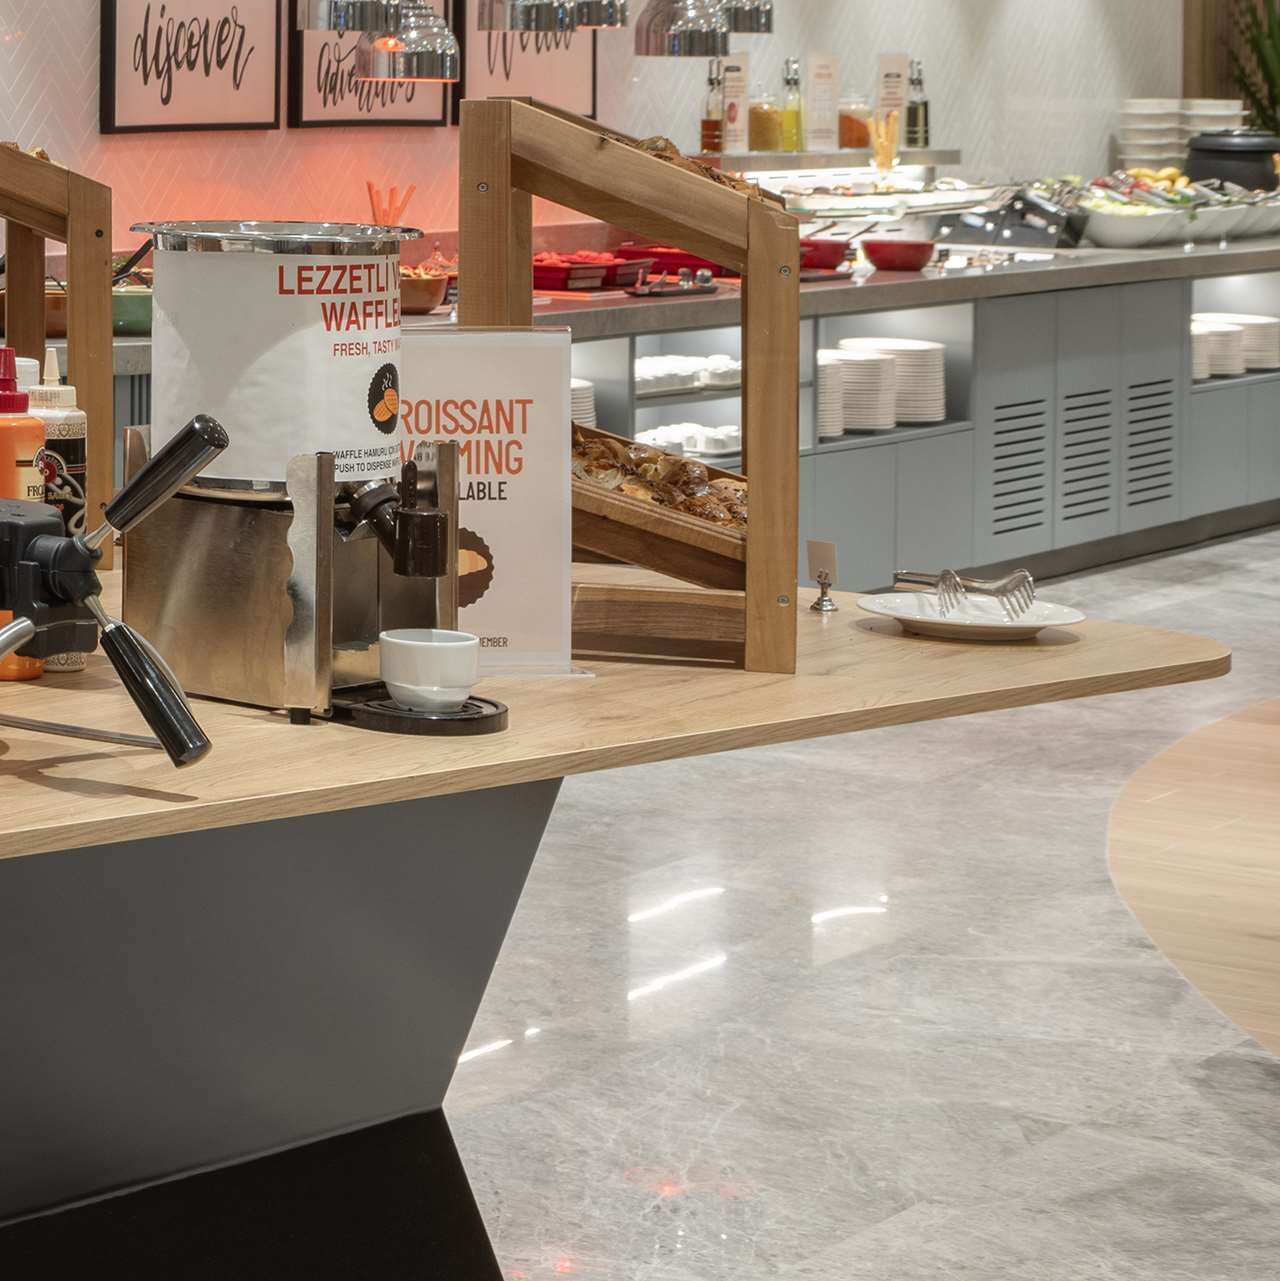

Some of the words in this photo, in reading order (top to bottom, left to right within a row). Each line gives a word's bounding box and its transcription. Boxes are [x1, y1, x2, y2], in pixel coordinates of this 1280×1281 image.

[134, 3, 255, 105] discover
[321, 298, 400, 331] WAFFLE
[401, 399, 534, 435] ROISSANT
[334, 463, 355, 473] PUSH
[356, 462, 366, 472] TO
[27, 485, 44, 497] FRO
[458, 481, 507, 501] LABLE
